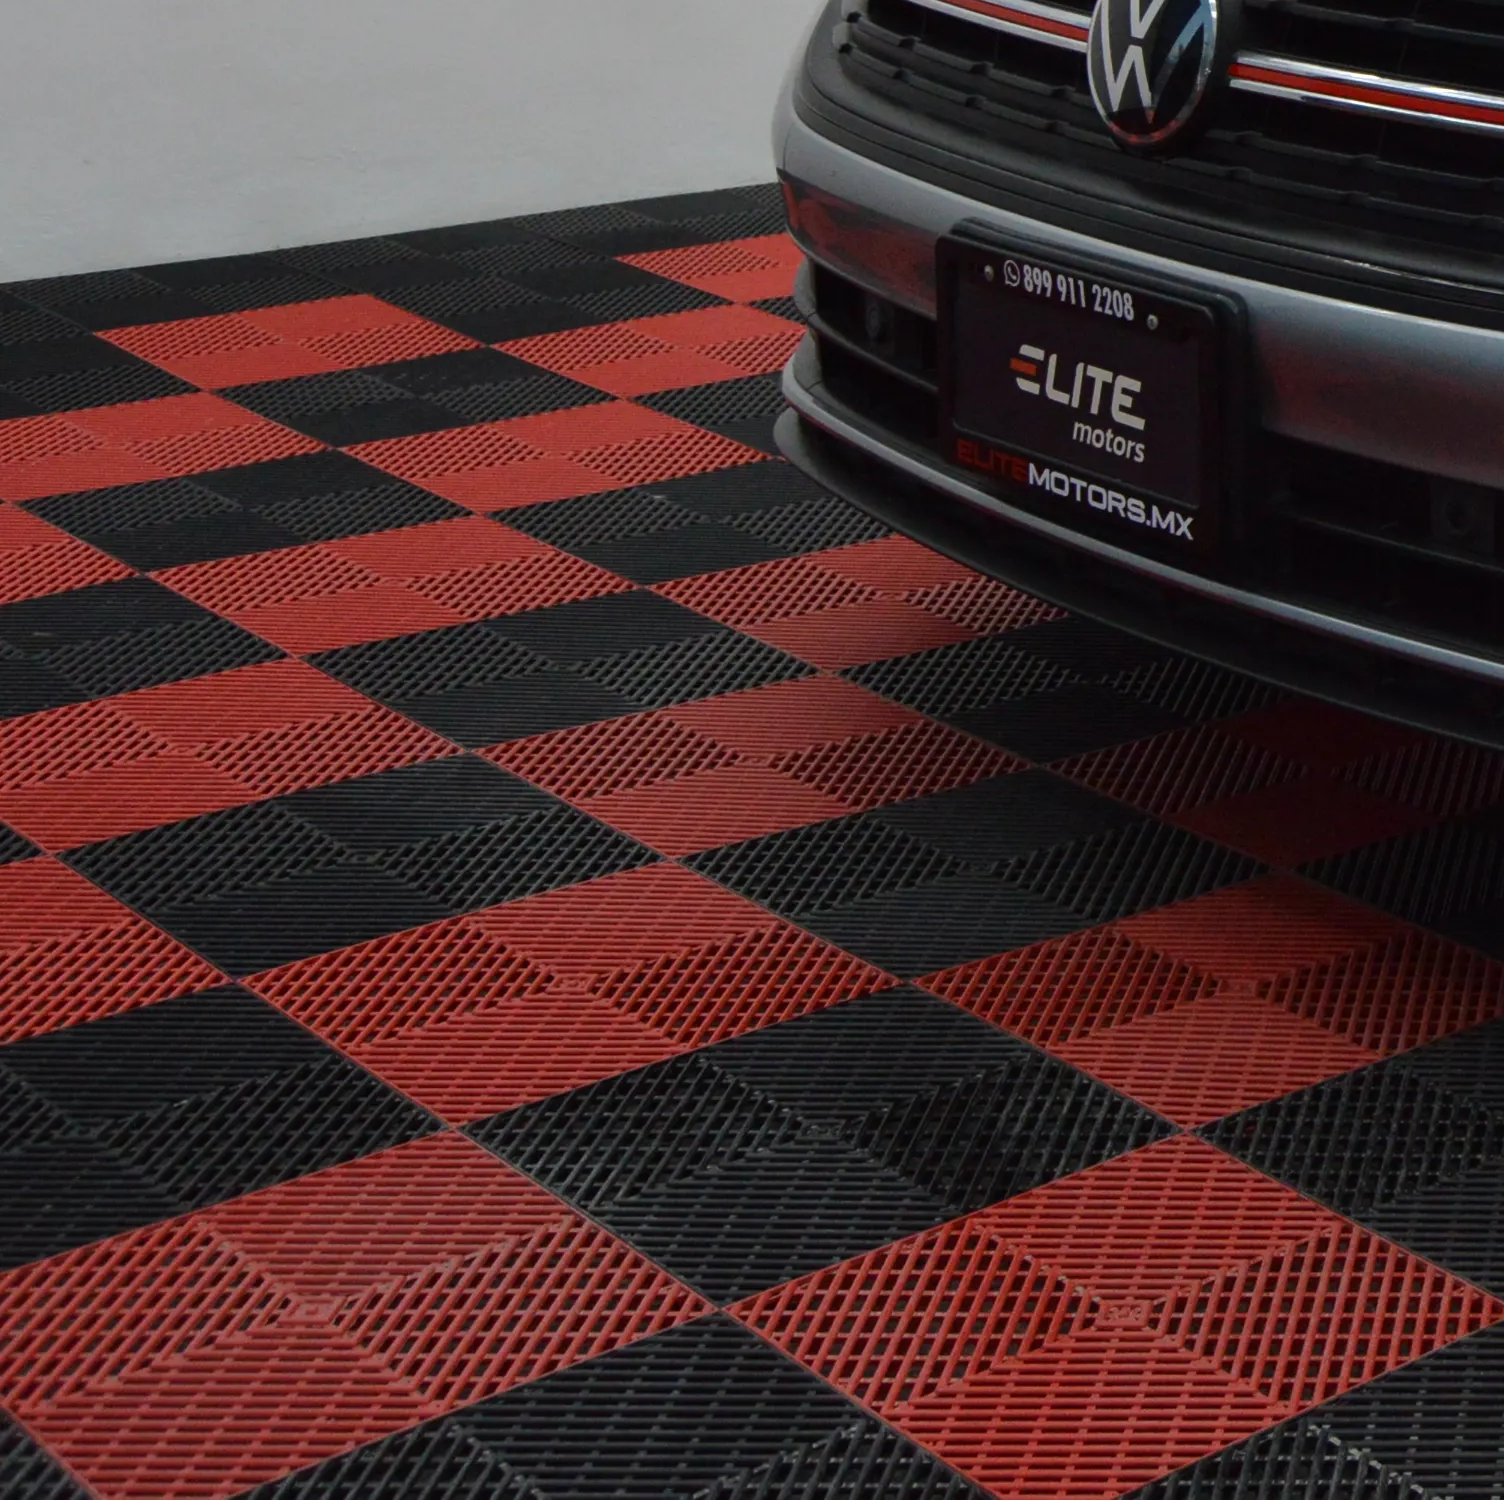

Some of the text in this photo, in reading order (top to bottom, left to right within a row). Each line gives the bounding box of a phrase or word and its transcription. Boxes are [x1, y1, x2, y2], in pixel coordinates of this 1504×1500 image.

[1023, 263, 1134, 321] 899 911 2208
[1009, 343, 1147, 431] ELITE
[1072, 420, 1145, 463] motors
